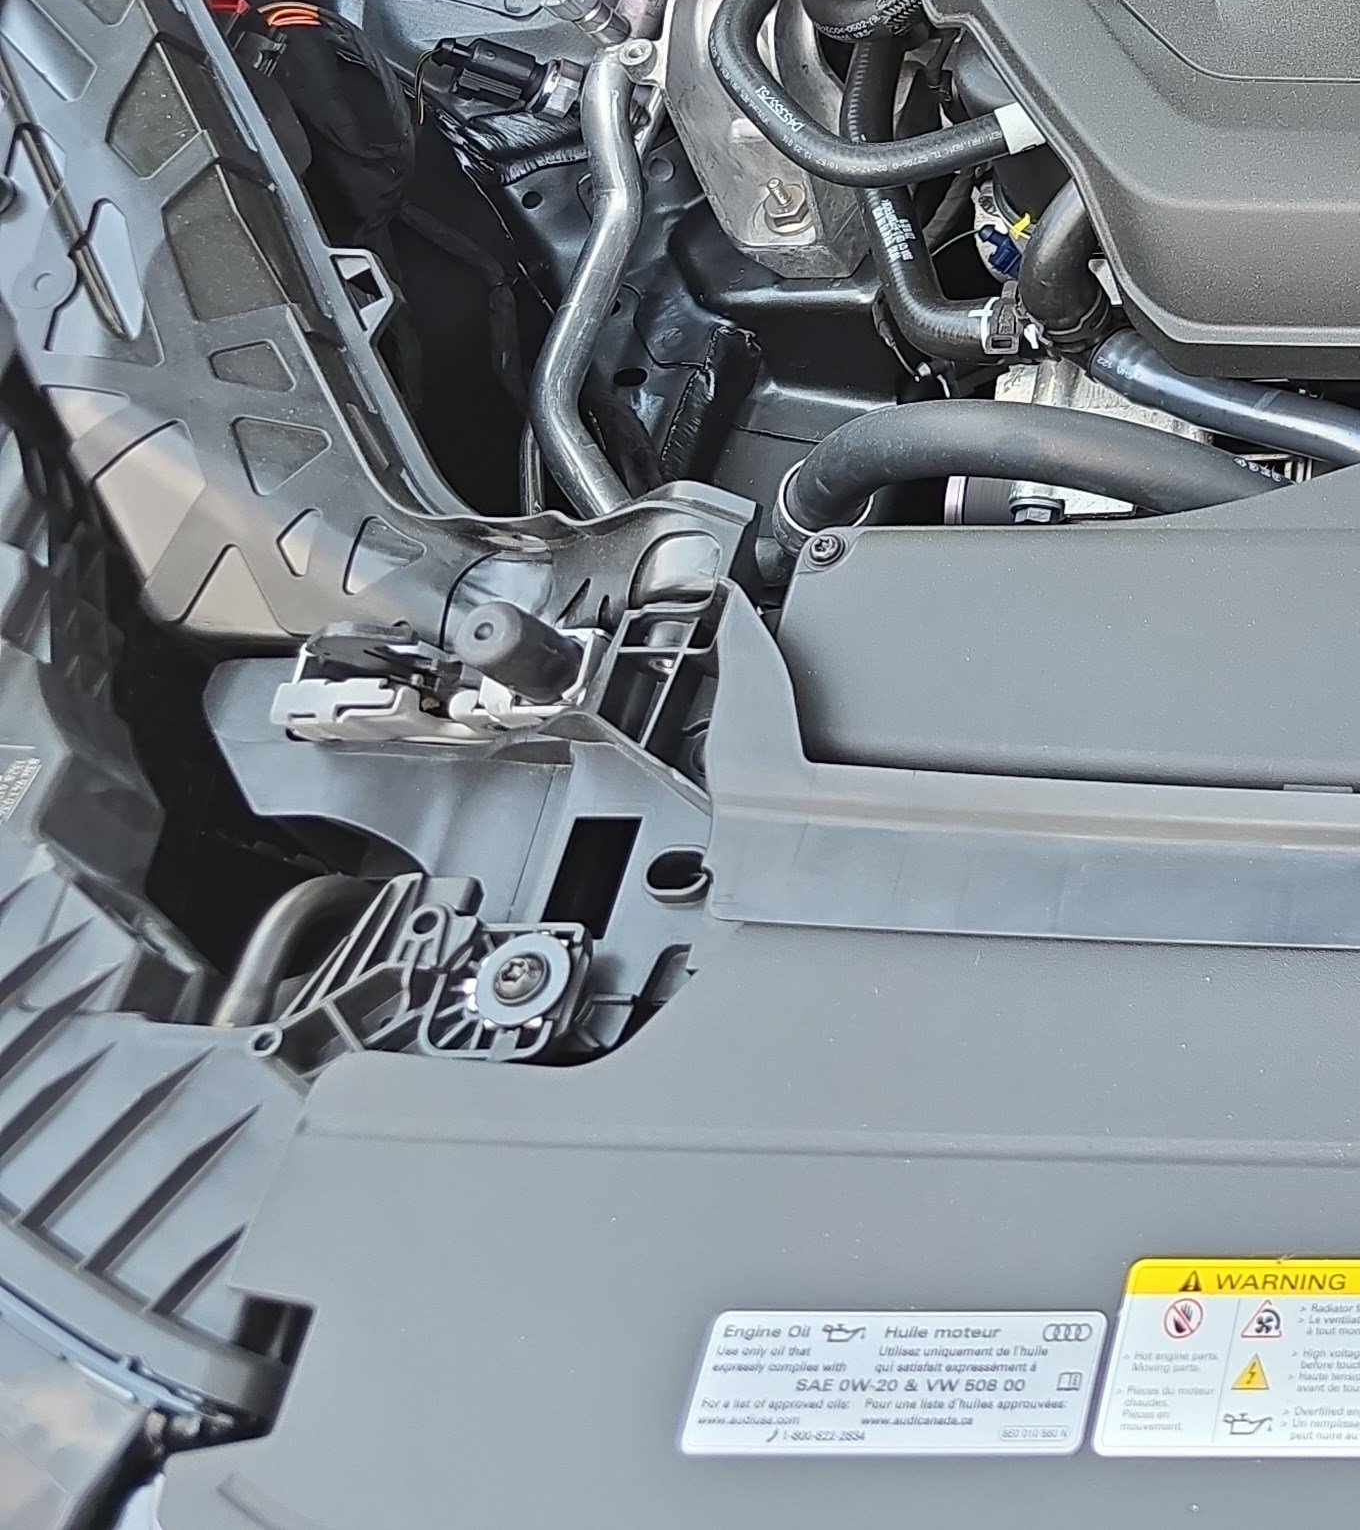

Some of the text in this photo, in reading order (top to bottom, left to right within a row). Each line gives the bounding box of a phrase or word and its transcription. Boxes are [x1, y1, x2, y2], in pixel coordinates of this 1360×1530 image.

[1216, 1272, 1347, 1291] WARNING
[1311, 1303, 1353, 1313] Radiator
[1309, 1315, 1319, 1324] Le
[723, 1324, 810, 1340] Engine Oil
[884, 1325, 1001, 1339] Huile moteur
[1316, 1327, 1335, 1335] tout
[717, 1345, 811, 1358] Use only oil that
[879, 1346, 921, 1357] Utilisez
[923, 1347, 993, 1359] uniquement
[996, 1346, 1010, 1357] de
[1303, 1348, 1326, 1362] High
[1155, 1353, 1189, 1363] engine
[712, 1362, 847, 1373] expressly complies with
[874, 1363, 894, 1374] qui
[896, 1363, 943, 1373] satisfait
[945, 1363, 1027, 1375] expressément
[1301, 1360, 1333, 1370] before
[1299, 1372, 1328, 1381] Haute
[796, 1378, 1026, 1392] SAE 0W-20 & VW 508 00
[1296, 1384, 1326, 1393] avant
[1328, 1384, 1340, 1393] de
[701, 1398, 721, 1408] For
[733, 1398, 750, 1408] list
[753, 1398, 765, 1408] of
[768, 1398, 823, 1411] approved
[827, 1398, 851, 1409] oils:
[864, 1399, 892, 1409] Pour
[895, 1400, 917, 1409] une
[920, 1399, 944, 1409] liste
[1294, 1406, 1343, 1417] Overfilled
[698, 1415, 973, 1426] www.audiusa.com www.audicanada.ca
[1292, 1419, 1306, 1428] Un
